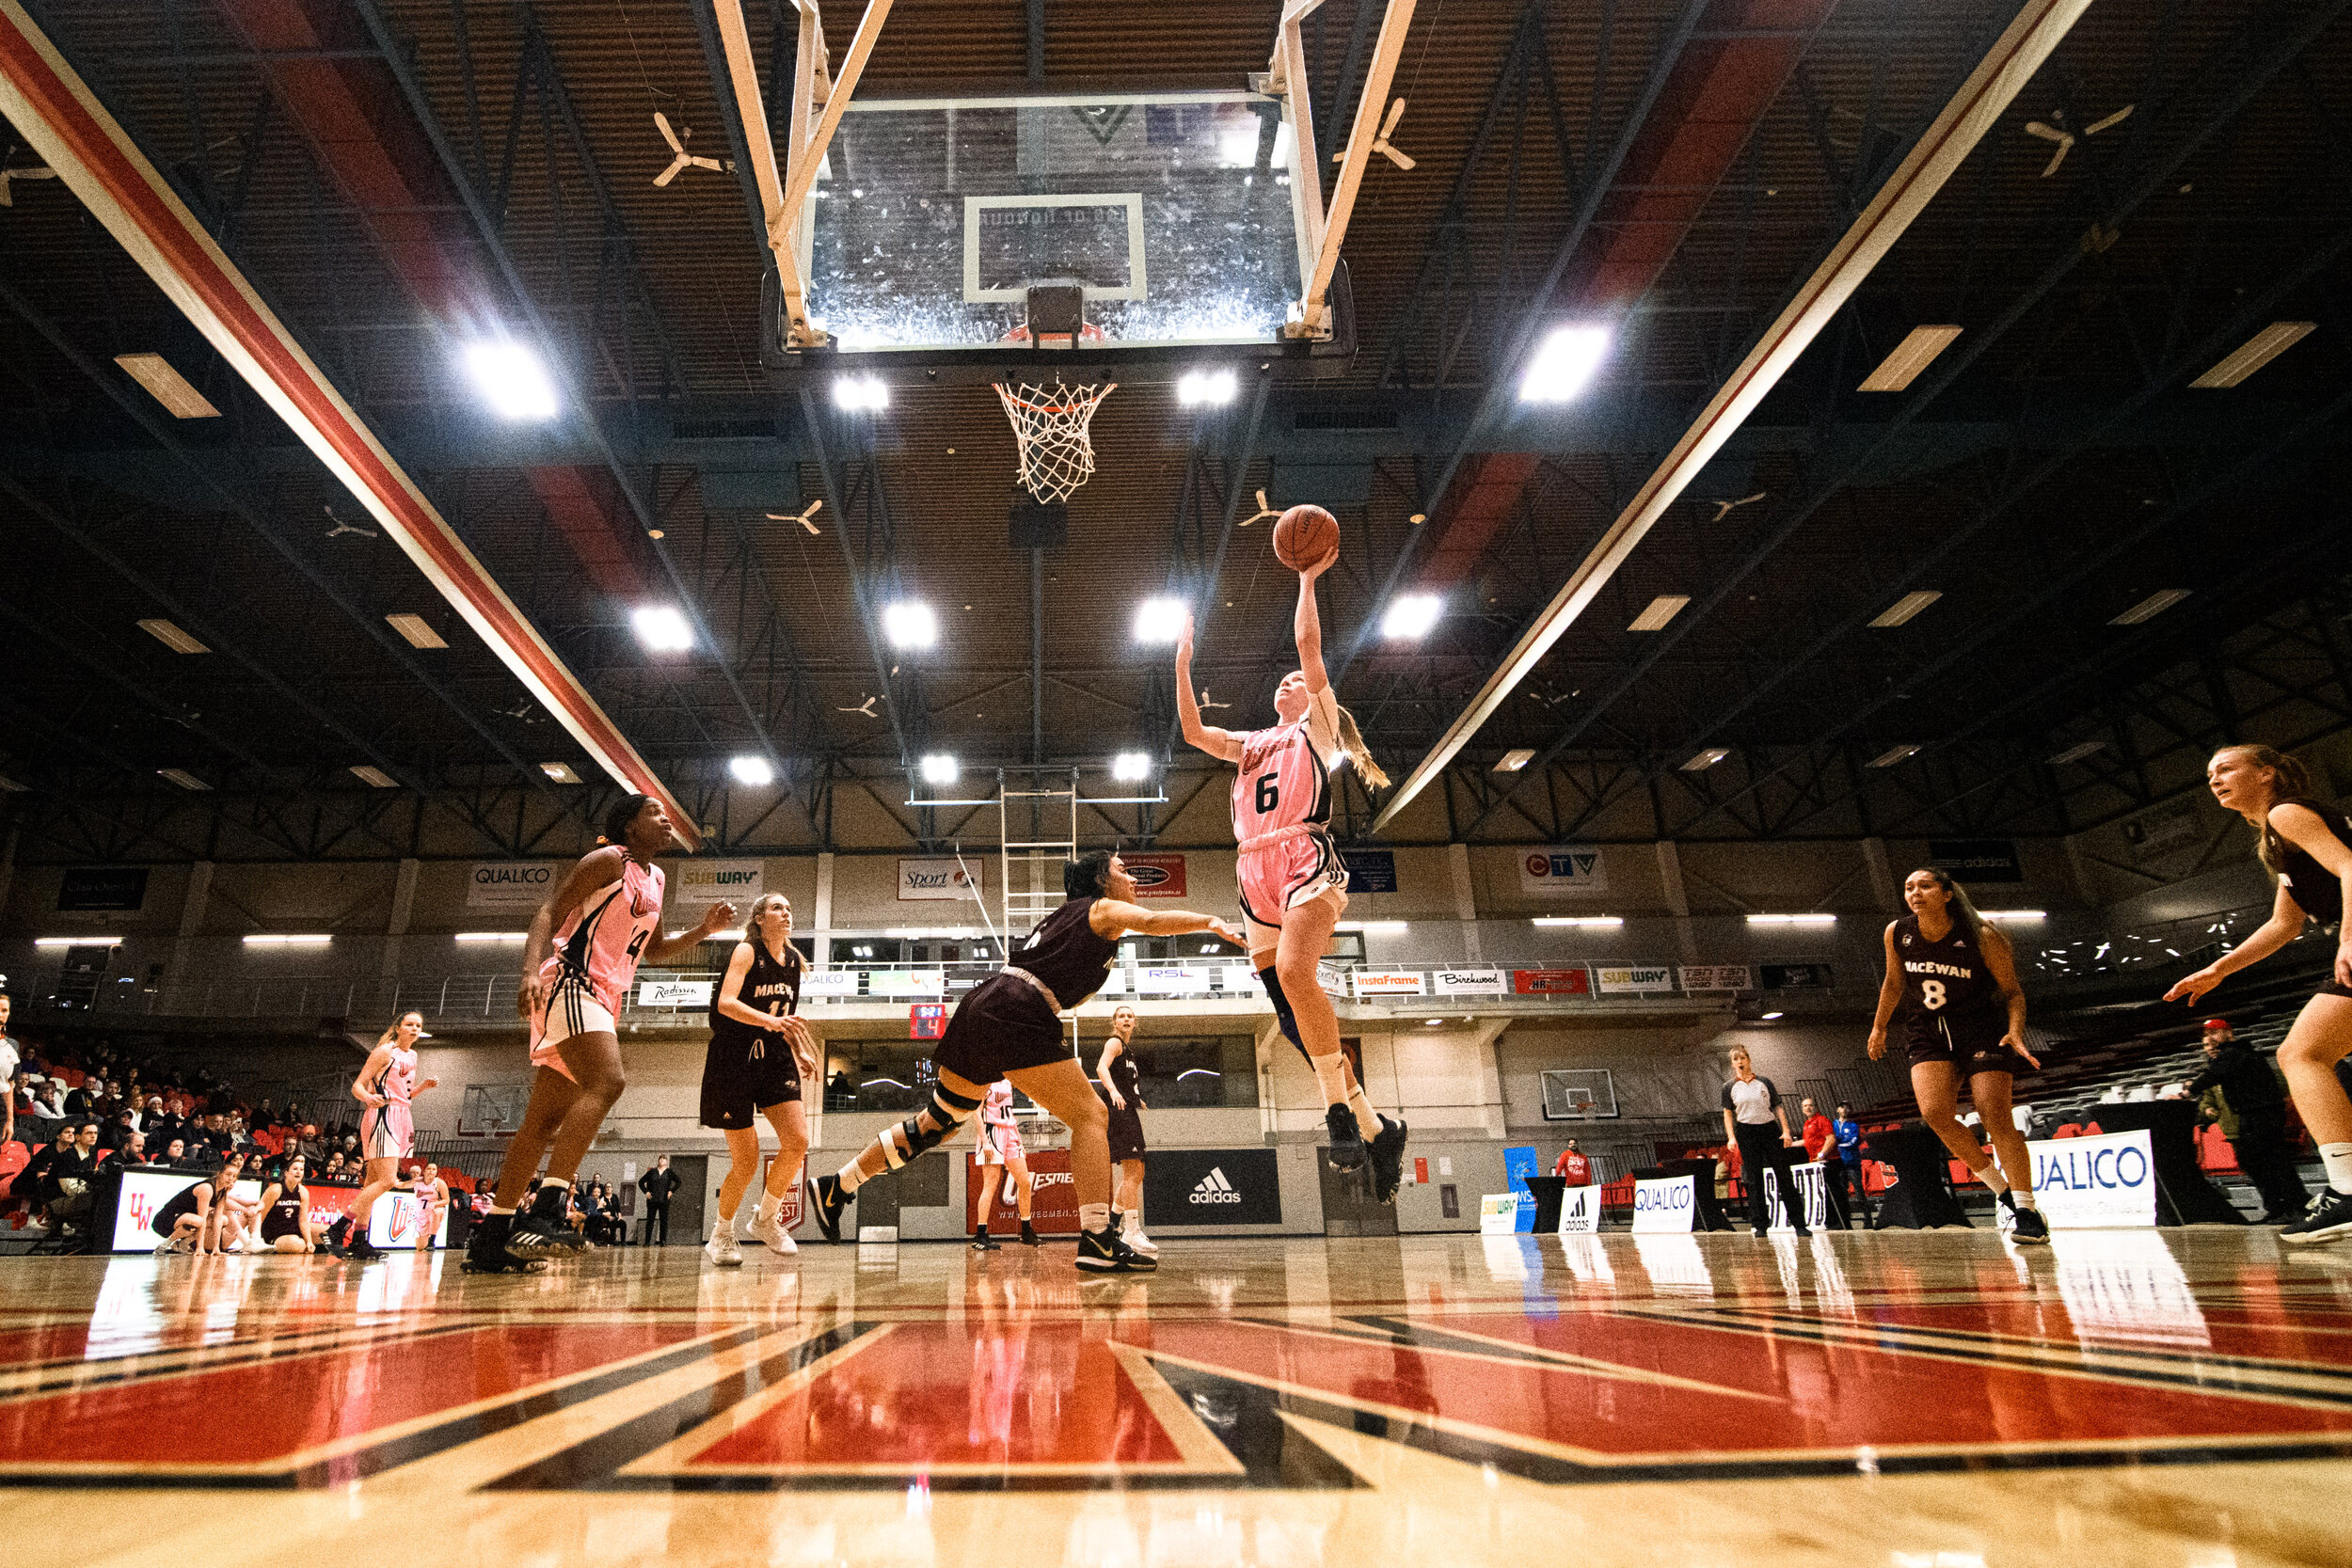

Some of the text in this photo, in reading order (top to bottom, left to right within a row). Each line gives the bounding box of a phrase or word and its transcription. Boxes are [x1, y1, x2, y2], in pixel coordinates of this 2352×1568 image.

[1256, 772, 1279, 815] 6
[1526, 854, 1597, 877] CTV
[476, 868, 549, 883] QUALICO
[682, 871, 757, 885] SUBWAY
[905, 871, 947, 888] Sport
[1358, 975, 1419, 986] InstaFrame
[1438, 973, 1501, 984] Birchwood
[1603, 971, 1667, 983] SUBWAY
[1532, 980, 1547, 990] HR
[1921, 980, 1947, 1010] 8
[928, 1019, 939, 1036] 4
[1189, 1191, 1242, 1203] adidas
[1634, 1185, 1690, 1212] QUALICO
[421, 1199, 428, 1210] 7
[1483, 1199, 1516, 1215] SUBWAY
[1565, 1220, 1589, 1231] adidas
